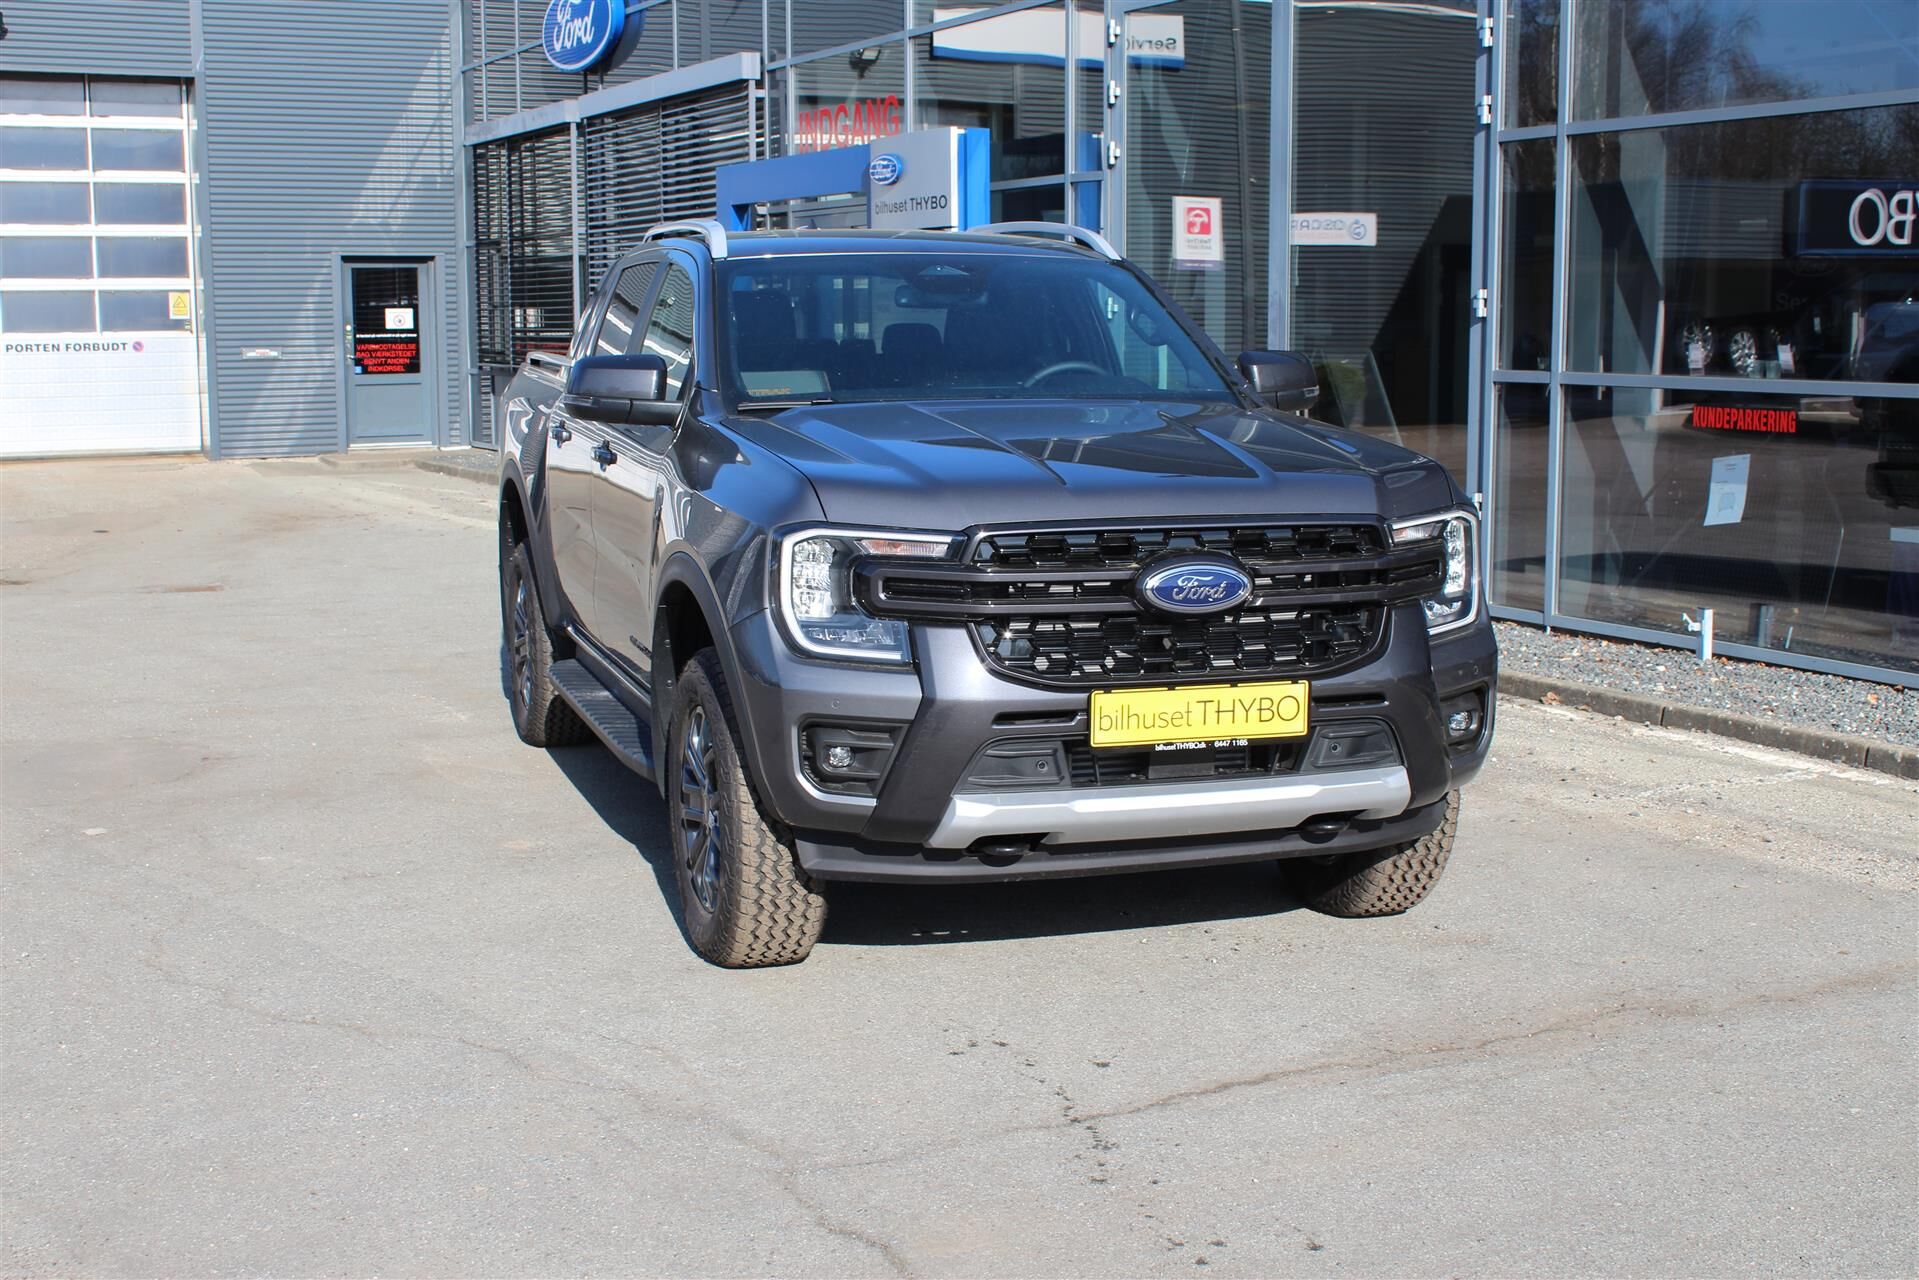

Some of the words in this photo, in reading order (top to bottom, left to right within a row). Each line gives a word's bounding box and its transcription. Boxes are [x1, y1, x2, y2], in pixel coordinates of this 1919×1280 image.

[554, 0, 595, 52] Ford
[798, 93, 900, 154] INDGANG
[875, 199, 908, 215] bilhuset
[909, 194, 948, 211] THYBO
[5, 343, 60, 353] PORTEN
[65, 342, 128, 352] FORBUDT
[1692, 406, 1797, 433] KUNDEPARKERING
[1172, 575, 1227, 601] Ford
[1214, 740, 1230, 748] 6447
